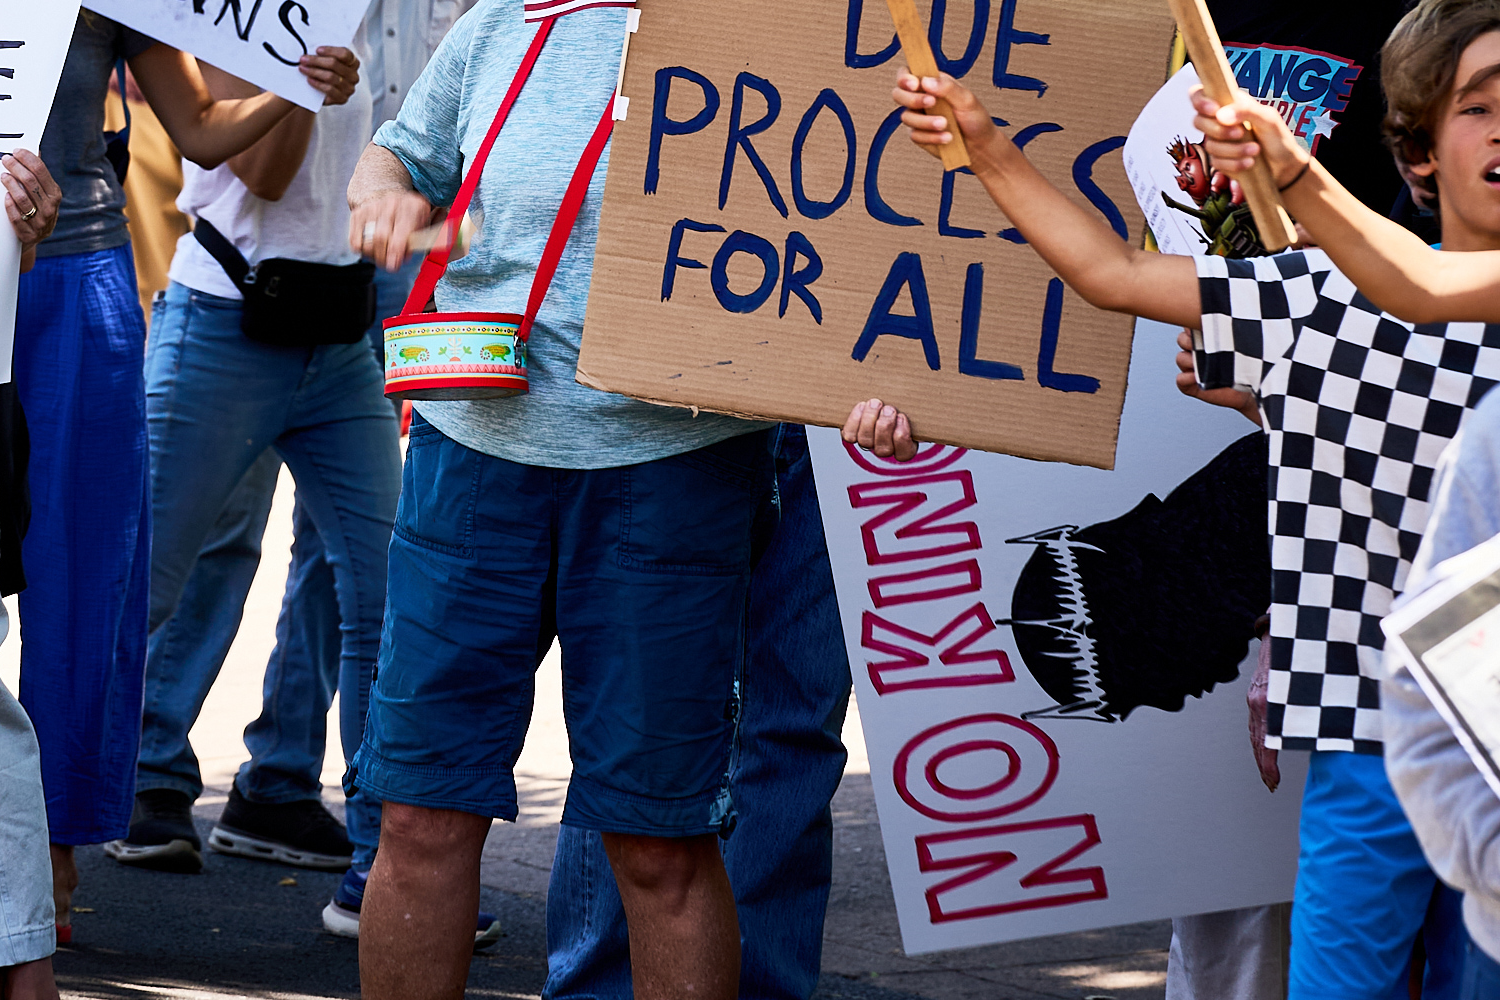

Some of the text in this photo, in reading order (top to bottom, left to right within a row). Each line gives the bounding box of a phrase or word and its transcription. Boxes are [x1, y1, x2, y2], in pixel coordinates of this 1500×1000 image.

[661, 218, 823, 325] FOR
[851, 251, 1101, 394] ALL
[892, 712, 1109, 925] NO
